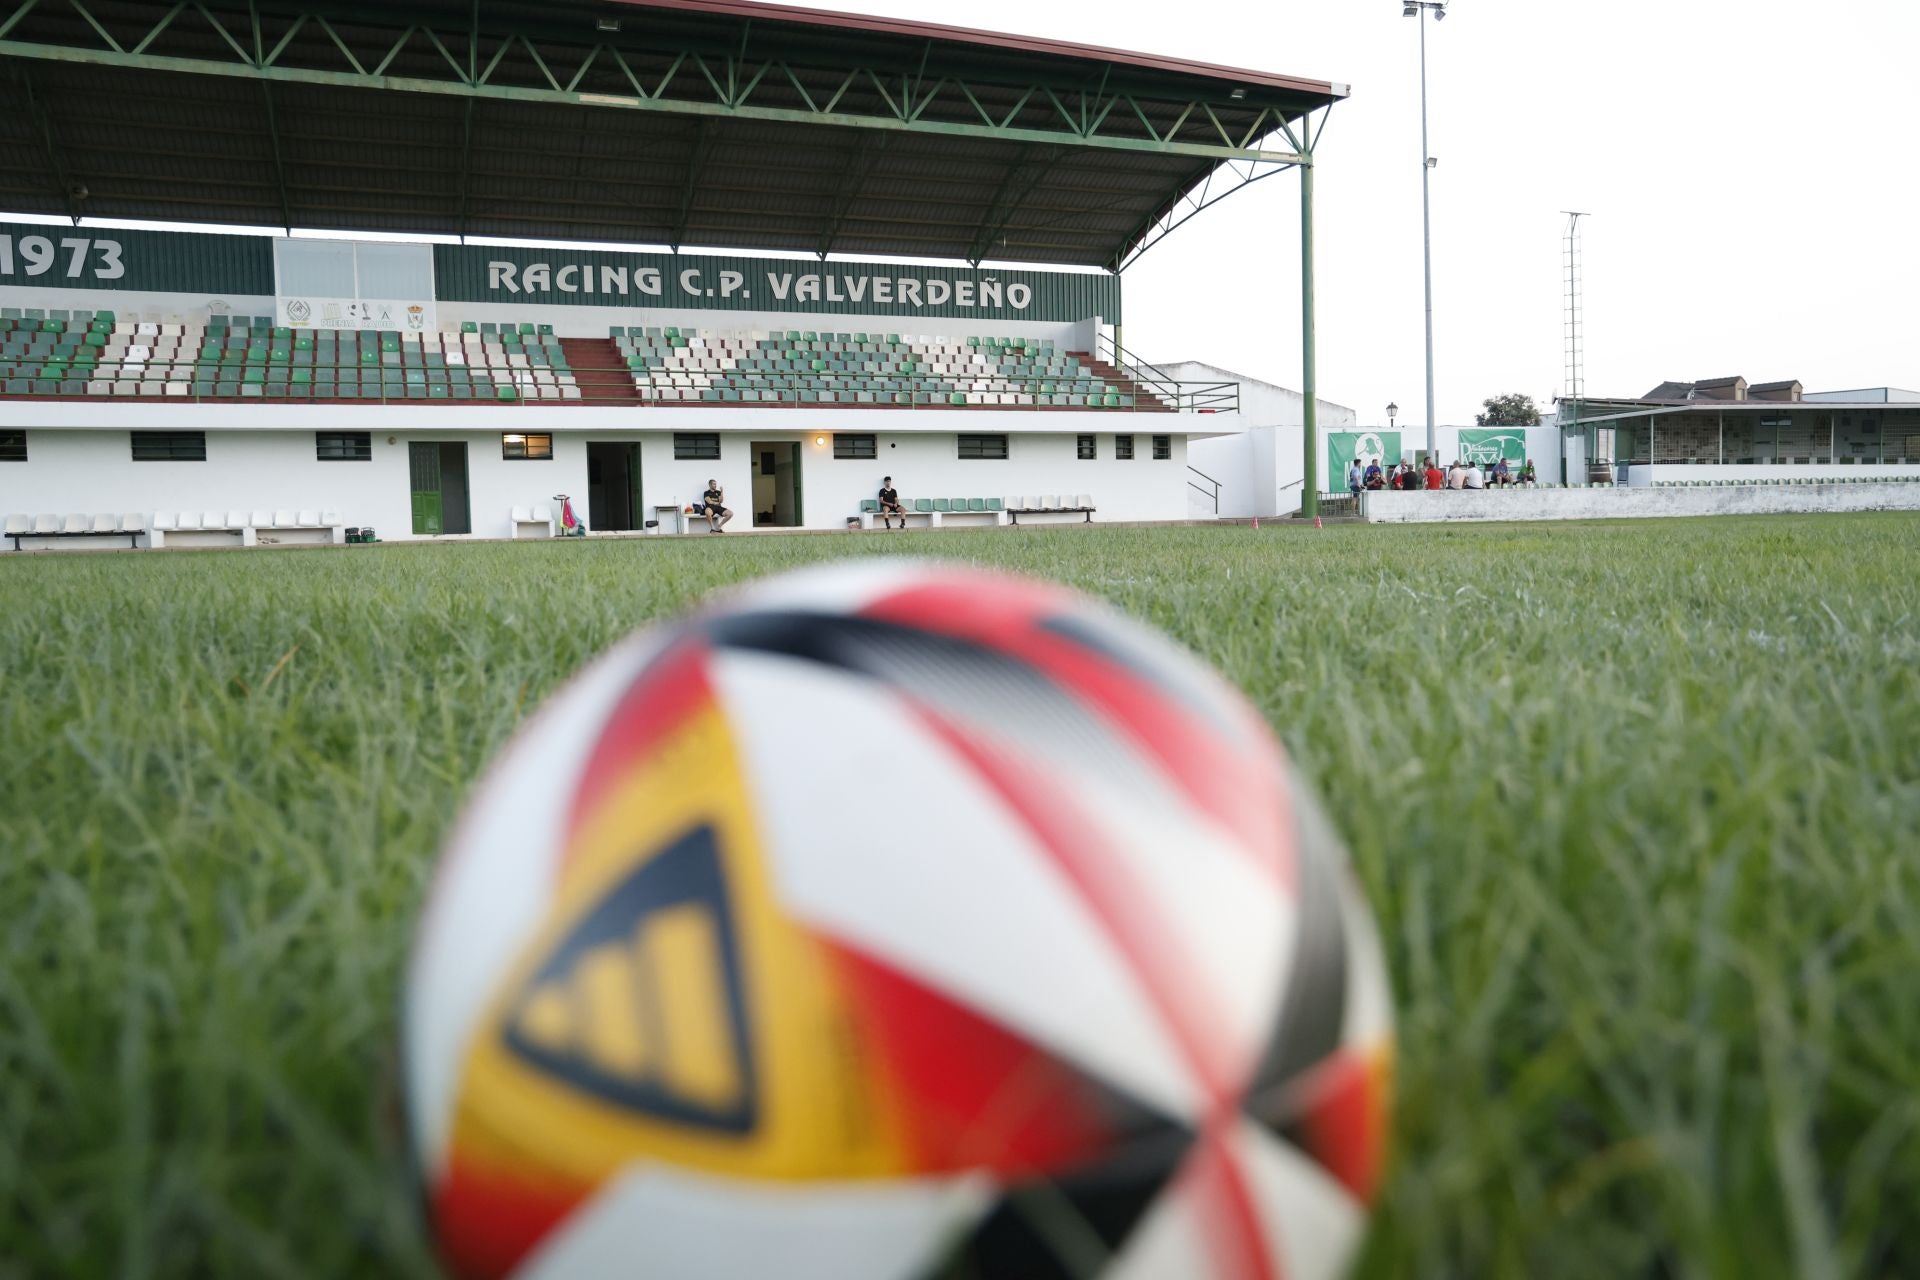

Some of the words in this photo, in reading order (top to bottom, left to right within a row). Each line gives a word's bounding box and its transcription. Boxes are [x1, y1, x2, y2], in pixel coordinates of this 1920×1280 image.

[0, 234, 125, 279] 1973
[488, 261, 662, 296] RACING
[680, 269, 750, 298] C.P.
[767, 272, 1032, 309] VALVERDEÑO
